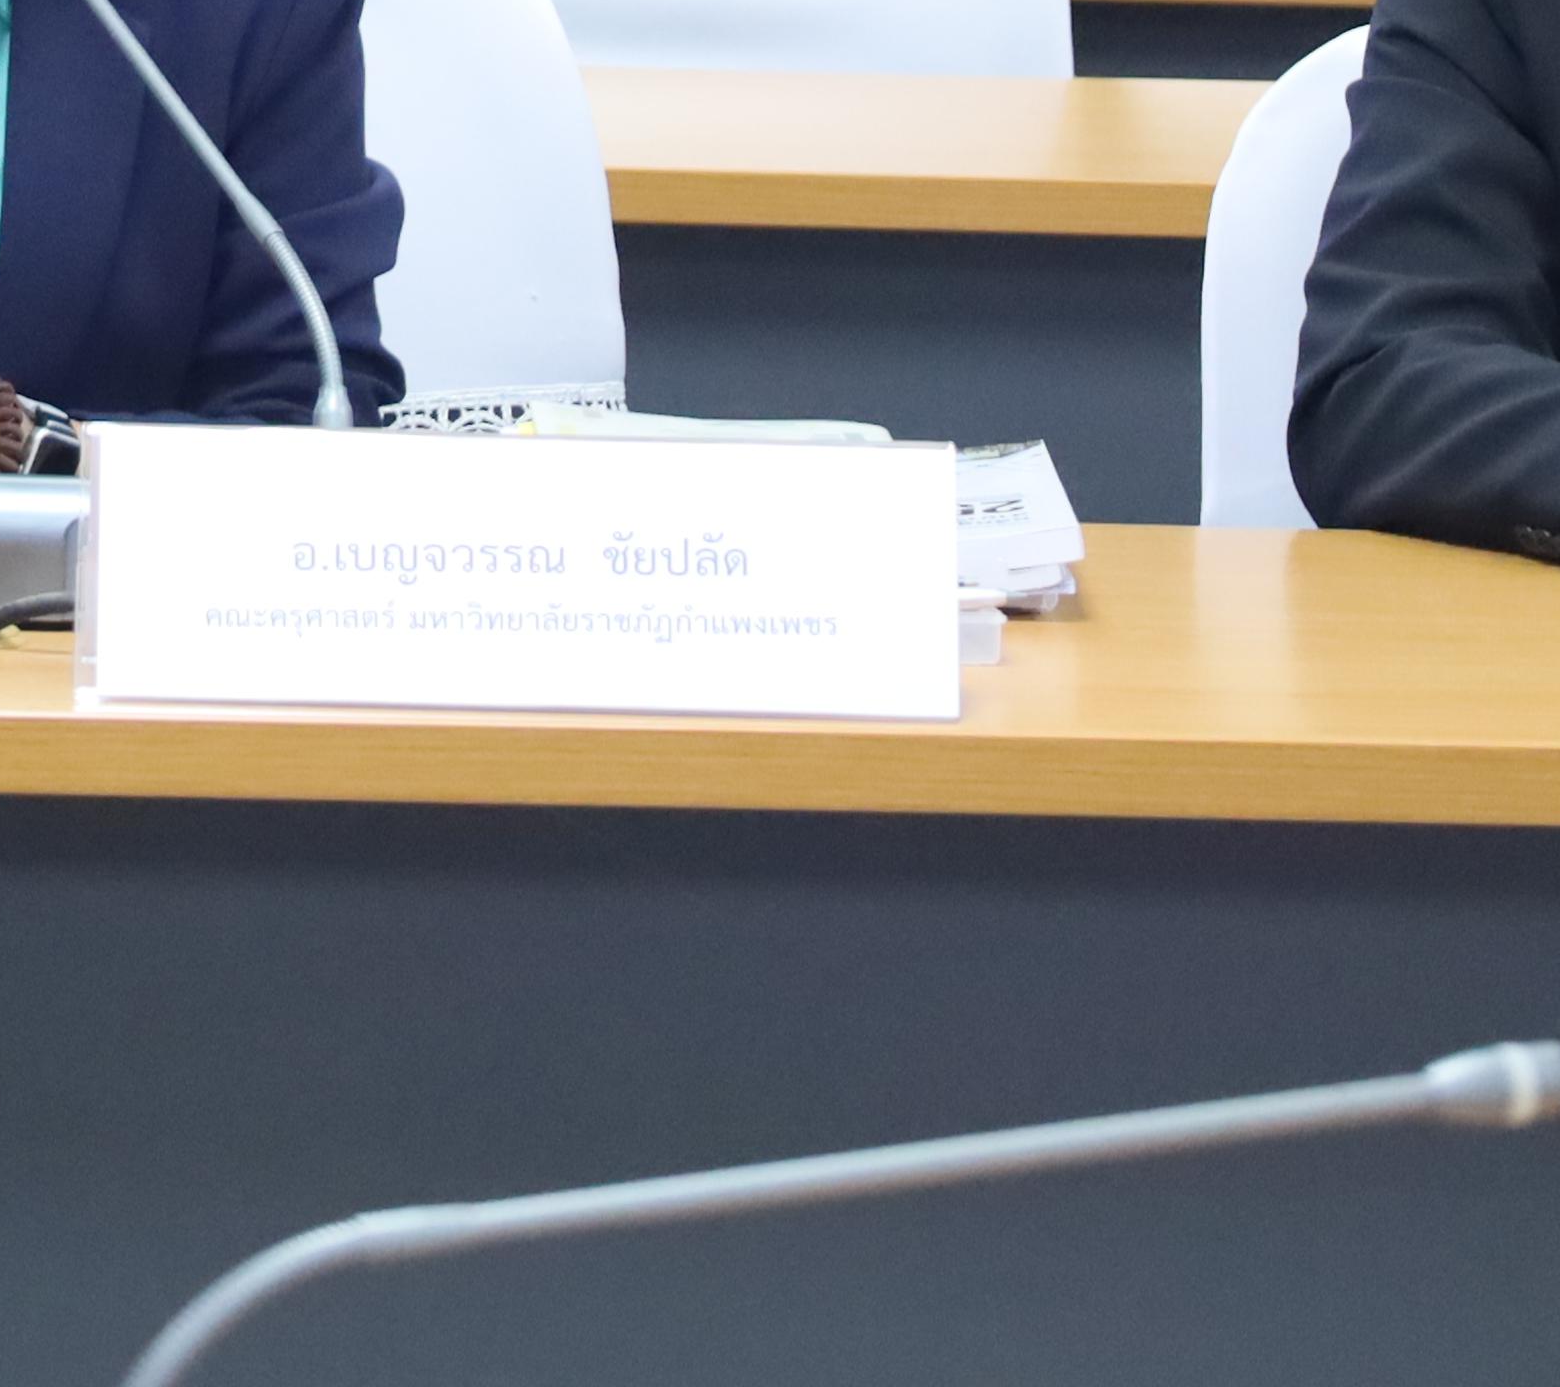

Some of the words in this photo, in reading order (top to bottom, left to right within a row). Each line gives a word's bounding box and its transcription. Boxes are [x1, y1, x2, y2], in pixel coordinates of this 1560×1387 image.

[292, 540, 566, 586] อ.เบญจวรรณ
[602, 530, 750, 577] ชัยปลัด
[205, 599, 396, 638] คณะครุศาสตร์
[408, 601, 839, 644] มหาวิทยาลัยราชภัฏกำแพงเพชร
